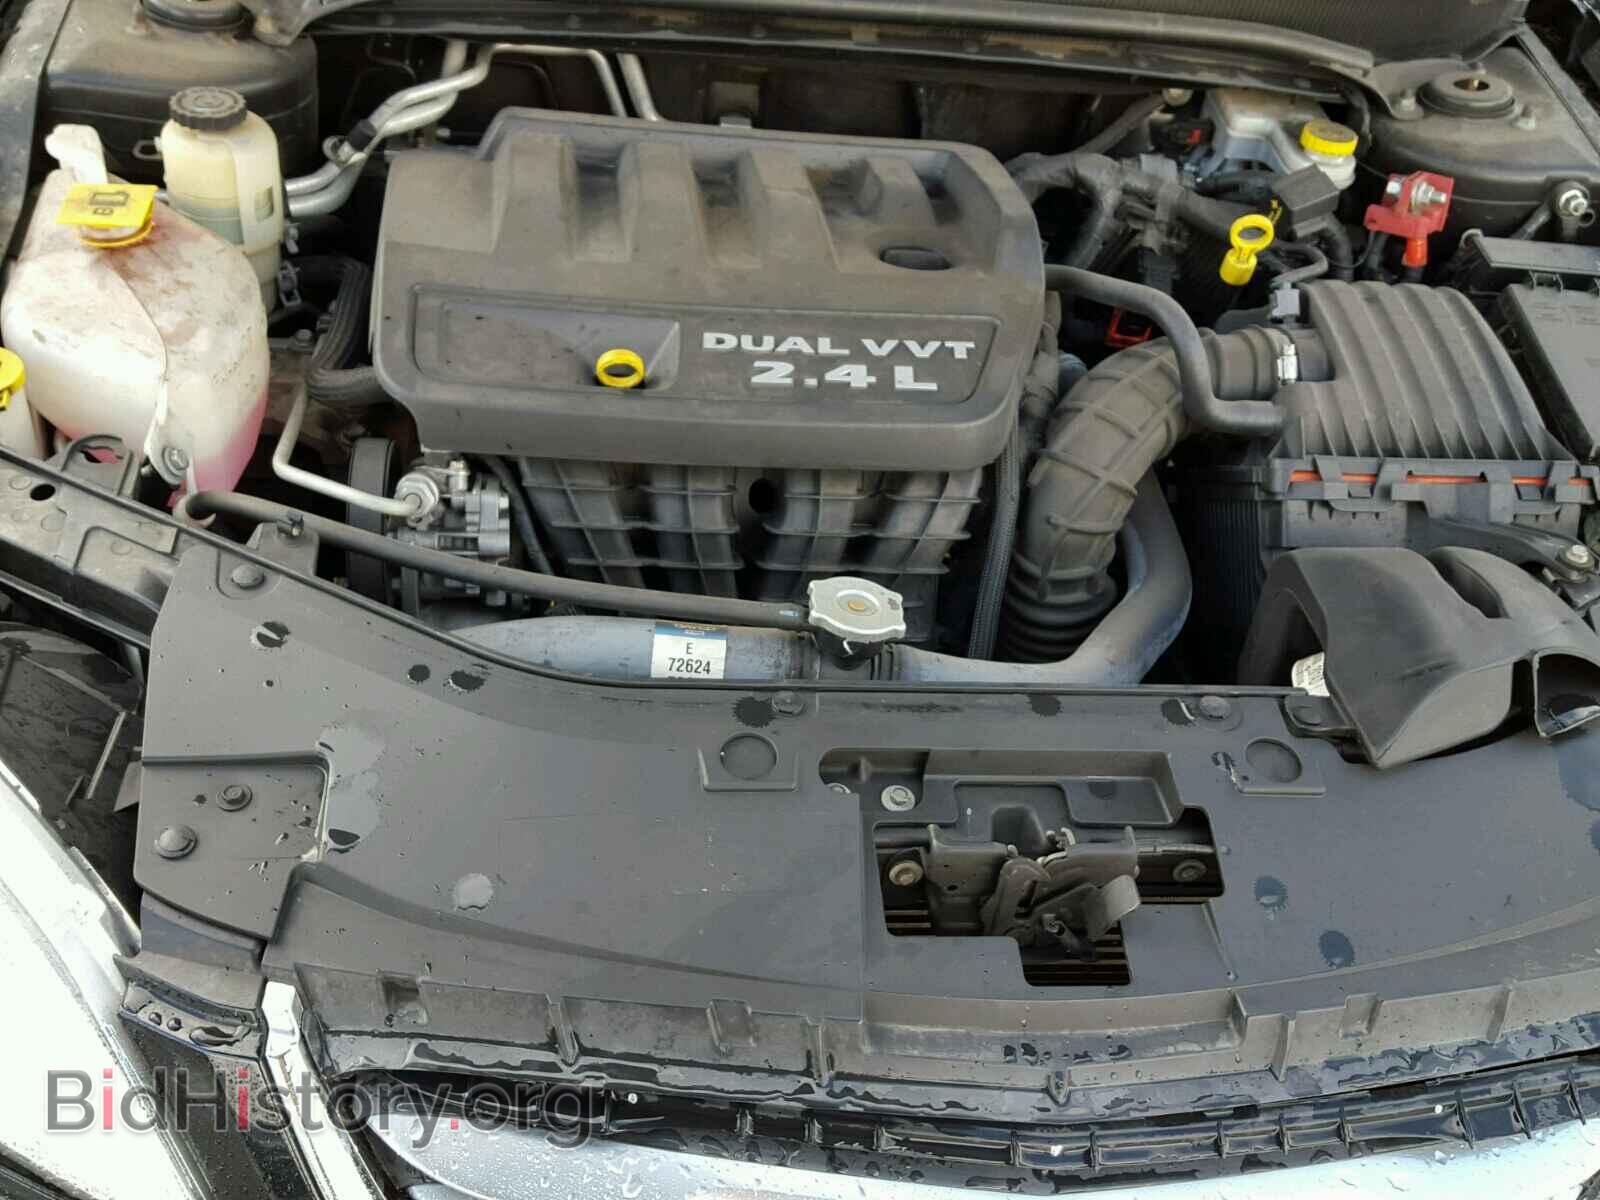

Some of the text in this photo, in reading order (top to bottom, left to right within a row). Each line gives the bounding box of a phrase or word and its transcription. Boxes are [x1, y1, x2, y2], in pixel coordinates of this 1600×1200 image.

[703, 332, 975, 359] DUAL VVT
[686, 642, 693, 655] E
[668, 657, 711, 675] 72624
